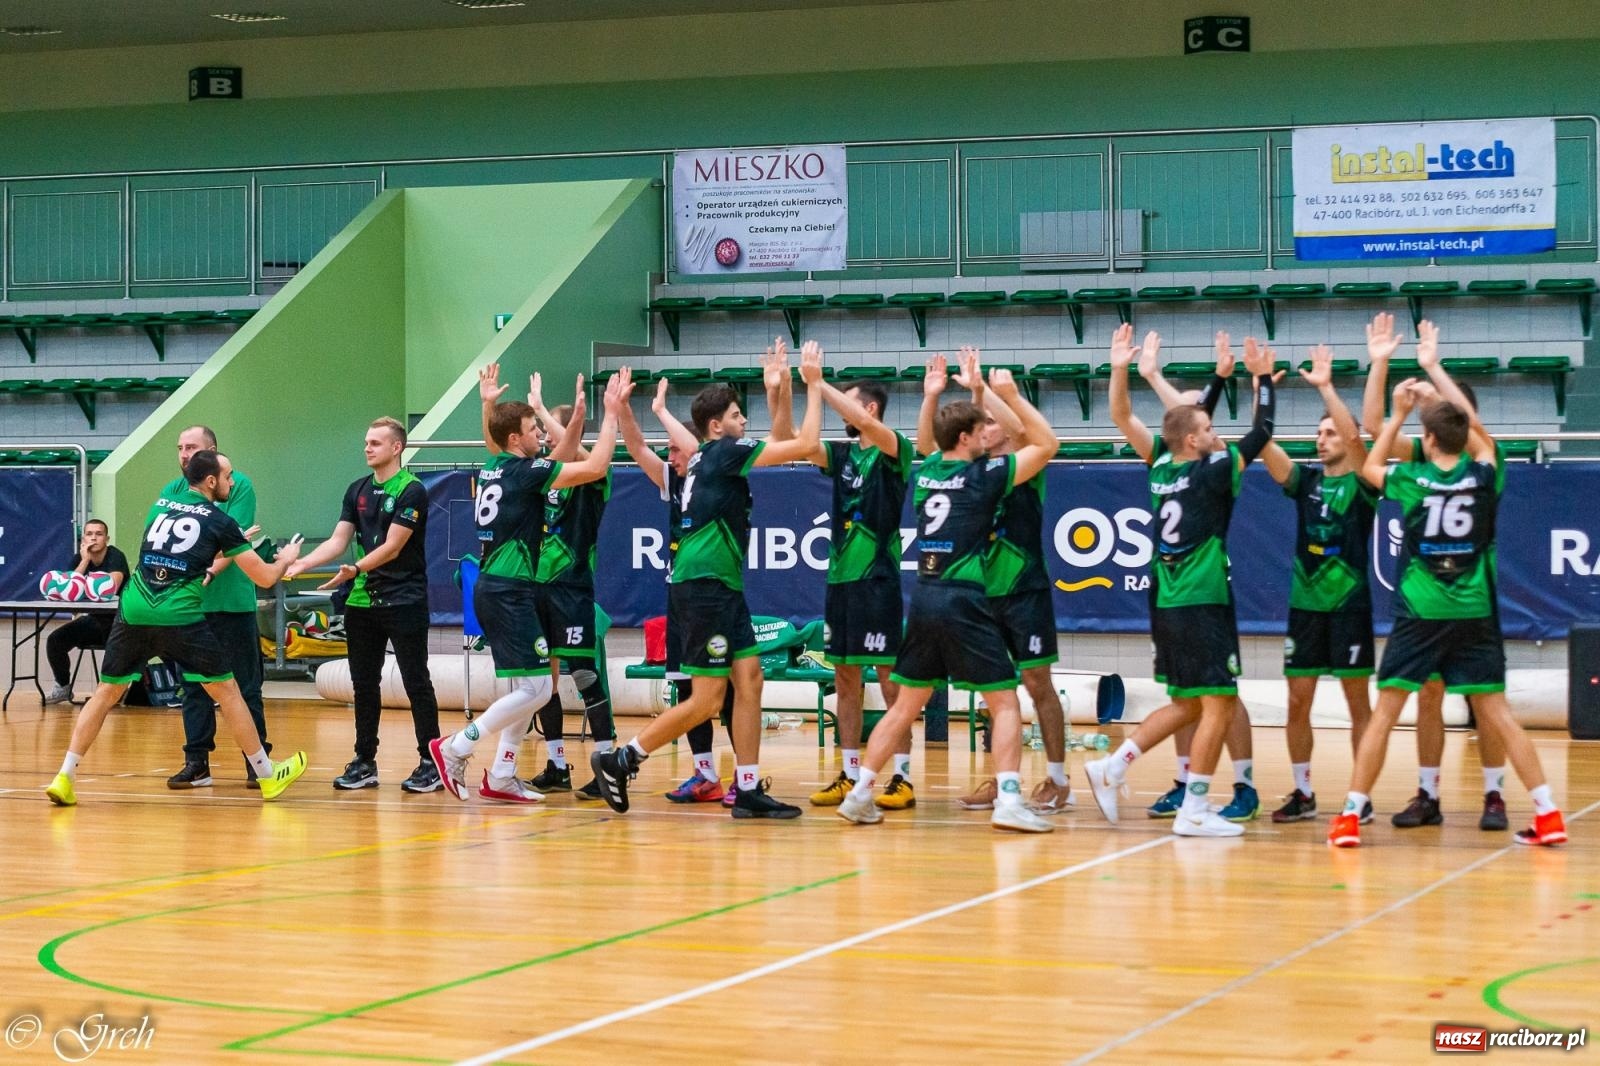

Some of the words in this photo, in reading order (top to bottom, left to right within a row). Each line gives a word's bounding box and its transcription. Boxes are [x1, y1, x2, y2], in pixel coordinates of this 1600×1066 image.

[1188, 28, 1204, 49] C
[1217, 27, 1243, 48] C
[191, 79, 198, 97] B
[209, 77, 233, 95] B
[694, 152, 825, 183] MIESZKO
[1331, 139, 1515, 183] instal-tech
[697, 201, 736, 210] Operator
[738, 199, 779, 208] urządzeń
[781, 197, 842, 207] cukierniczych
[1324, 195, 1337, 205] 32
[1340, 194, 1360, 204] 414
[1362, 194, 1376, 203] 92
[1401, 192, 1420, 202] 502
[1423, 191, 1443, 201] 632
[1475, 189, 1496, 199] 606
[1499, 188, 1519, 199] 363
[1522, 188, 1543, 197] 647
[697, 211, 742, 219] Pracownik
[745, 208, 799, 218] produkcyjny
[1313, 210, 1352, 220] 47-400
[1432, 208, 1453, 216] von
[1455, 203, 1527, 215] Eichendorffa
[1529, 203, 1536, 213] 2
[748, 225, 788, 234] Czekamy
[804, 223, 835, 232] Ciebie!
[1363, 237, 1485, 253] www.instal-tech.pl
[924, 493, 951, 535] 9
[1160, 500, 1183, 544] 2
[1422, 495, 1475, 537] 16
[146, 513, 200, 554] 49
[566, 626, 584, 645] 13
[864, 631, 887, 652] 44
[1028, 635, 1042, 655] 4
[504, 750, 515, 760] R
[557, 746, 564, 755] R
[699, 760, 710, 769] R
[850, 757, 858, 766] R
[743, 773, 754, 782] R
